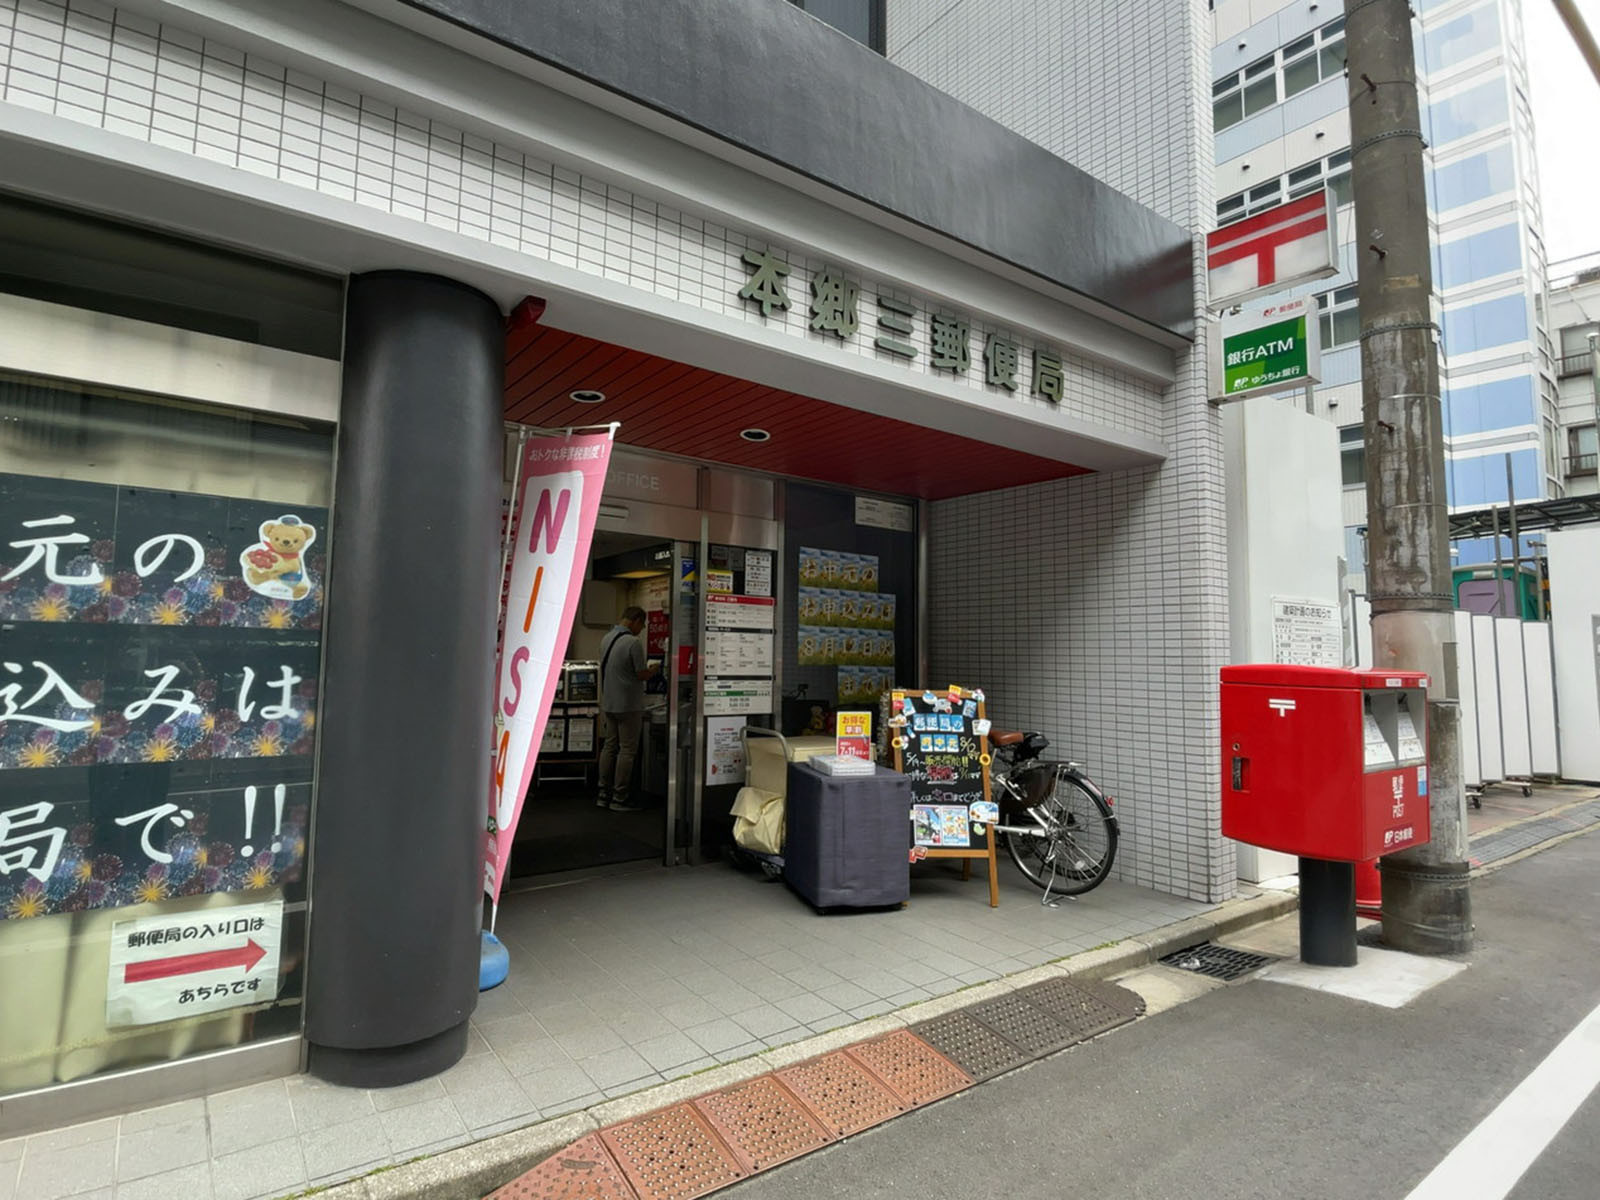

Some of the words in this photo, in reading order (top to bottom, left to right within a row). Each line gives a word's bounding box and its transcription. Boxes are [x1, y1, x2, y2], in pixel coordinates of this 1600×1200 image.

[737, 250, 1065, 404] 本郷三郵便局
[1226, 337, 1294, 366] 銀行ATM
[1251, 365, 1300, 385] ゆうちょ銀行
[0, 515, 205, 583] 元の
[0, 661, 303, 732] 込みは
[127, 917, 265, 948] 郵便局の入り口は
[178, 977, 262, 1004] あちらです
